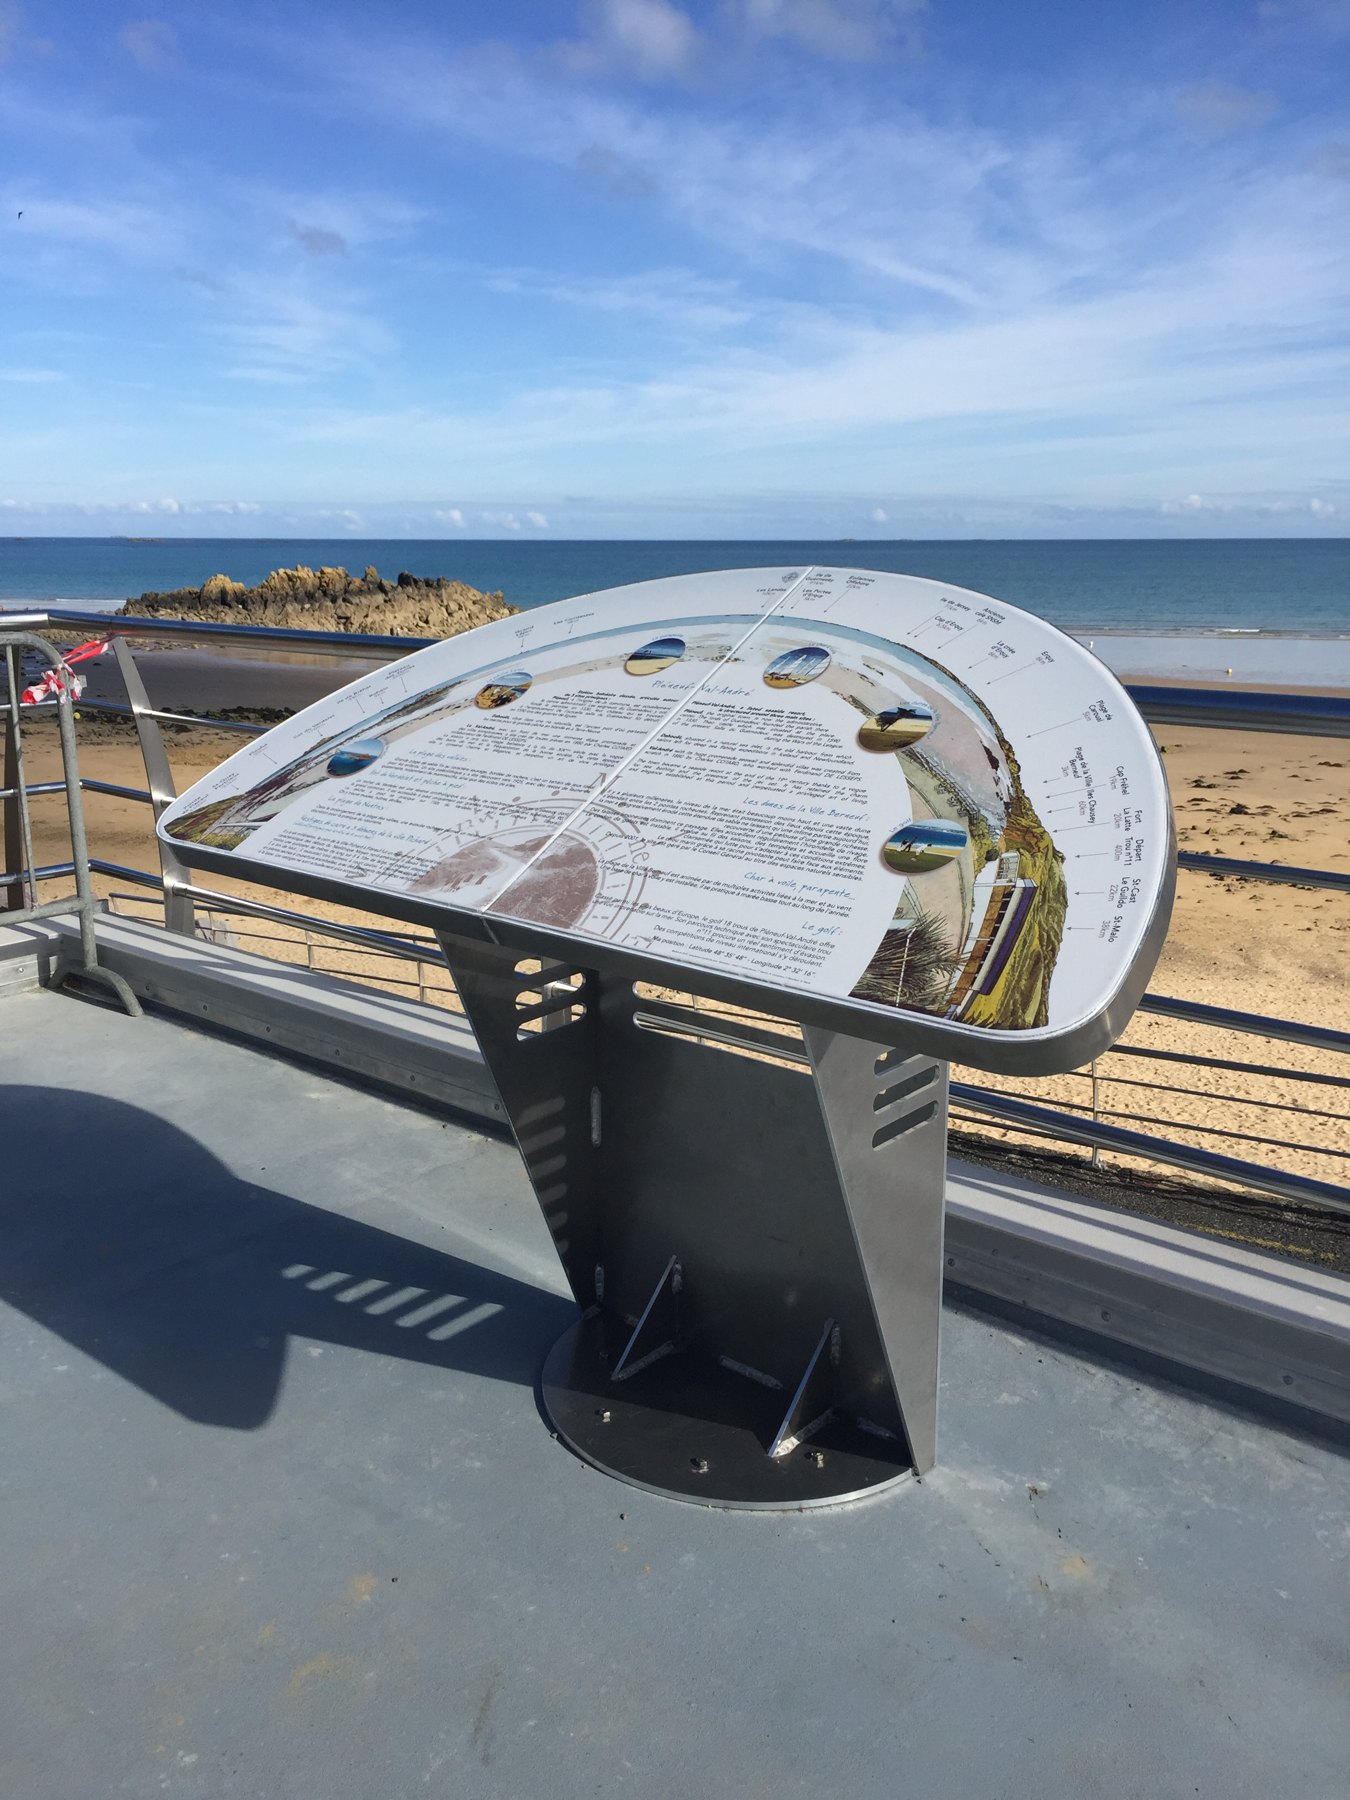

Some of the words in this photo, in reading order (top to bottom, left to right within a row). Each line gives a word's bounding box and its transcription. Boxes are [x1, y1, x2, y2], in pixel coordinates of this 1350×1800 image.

[1041, 651, 1055, 663] Erquy
[1096, 699, 1109, 714] Plage
[1069, 758, 1082, 779] Berneuf
[1075, 746, 1084, 761] Plage
[1085, 774, 1093, 787] Ville
[1116, 765, 1124, 778] Cap
[1120, 777, 1130, 796] Fréhel
[743, 797, 758, 806] Les
[761, 800, 783, 810] dunes
[785, 803, 797, 811] de
[800, 804, 806, 813] la
[809, 806, 825, 815] Ville
[827, 808, 867, 821] Berneuf
[1079, 800, 1087, 816] 60km
[1088, 799, 1097, 824] Chausey
[1123, 807, 1131, 815] La
[1135, 809, 1143, 824] Fort
[745, 810, 777, 820] beaucoup
[852, 826, 871, 834] dune
[1114, 813, 1122, 829] 20km
[1124, 815, 1132, 832] Latte
[1114, 844, 1123, 861] 400m
[1125, 837, 1133, 851] Trou
[1135, 839, 1144, 862] Départ
[743, 850, 775, 859] pivotante
[744, 872, 766, 882] Char
[768, 875, 774, 883] à
[777, 878, 798, 890] voile,
[1122, 876, 1130, 885] Le
[720, 882, 750, 891] multiples
[749, 888, 777, 896] activités
[775, 891, 792, 899] liées
[1108, 884, 1119, 901] 22km
[1117, 885, 1129, 908] Guildo
[1129, 878, 1141, 903] St-Cast
[651, 905, 672, 913] beaux
[731, 921, 749, 929] trous
[758, 927, 820, 944] Pléneuf-Val-André
[818, 940, 836, 948] offre
[801, 921, 814, 930] Le
[812, 925, 841, 936] golf
[1108, 915, 1123, 942] St-Malo
[665, 928, 706, 940] compétitions
[714, 939, 737, 947] niveau
[736, 943, 779, 956] international
[685, 920, 714, 929] parcours
[712, 924, 745, 935] technique
[772, 938, 817, 951] spectaculaire
[816, 946, 832, 954] trou
[709, 932, 737, 940] procure
[759, 942, 794, 953] sentiment
